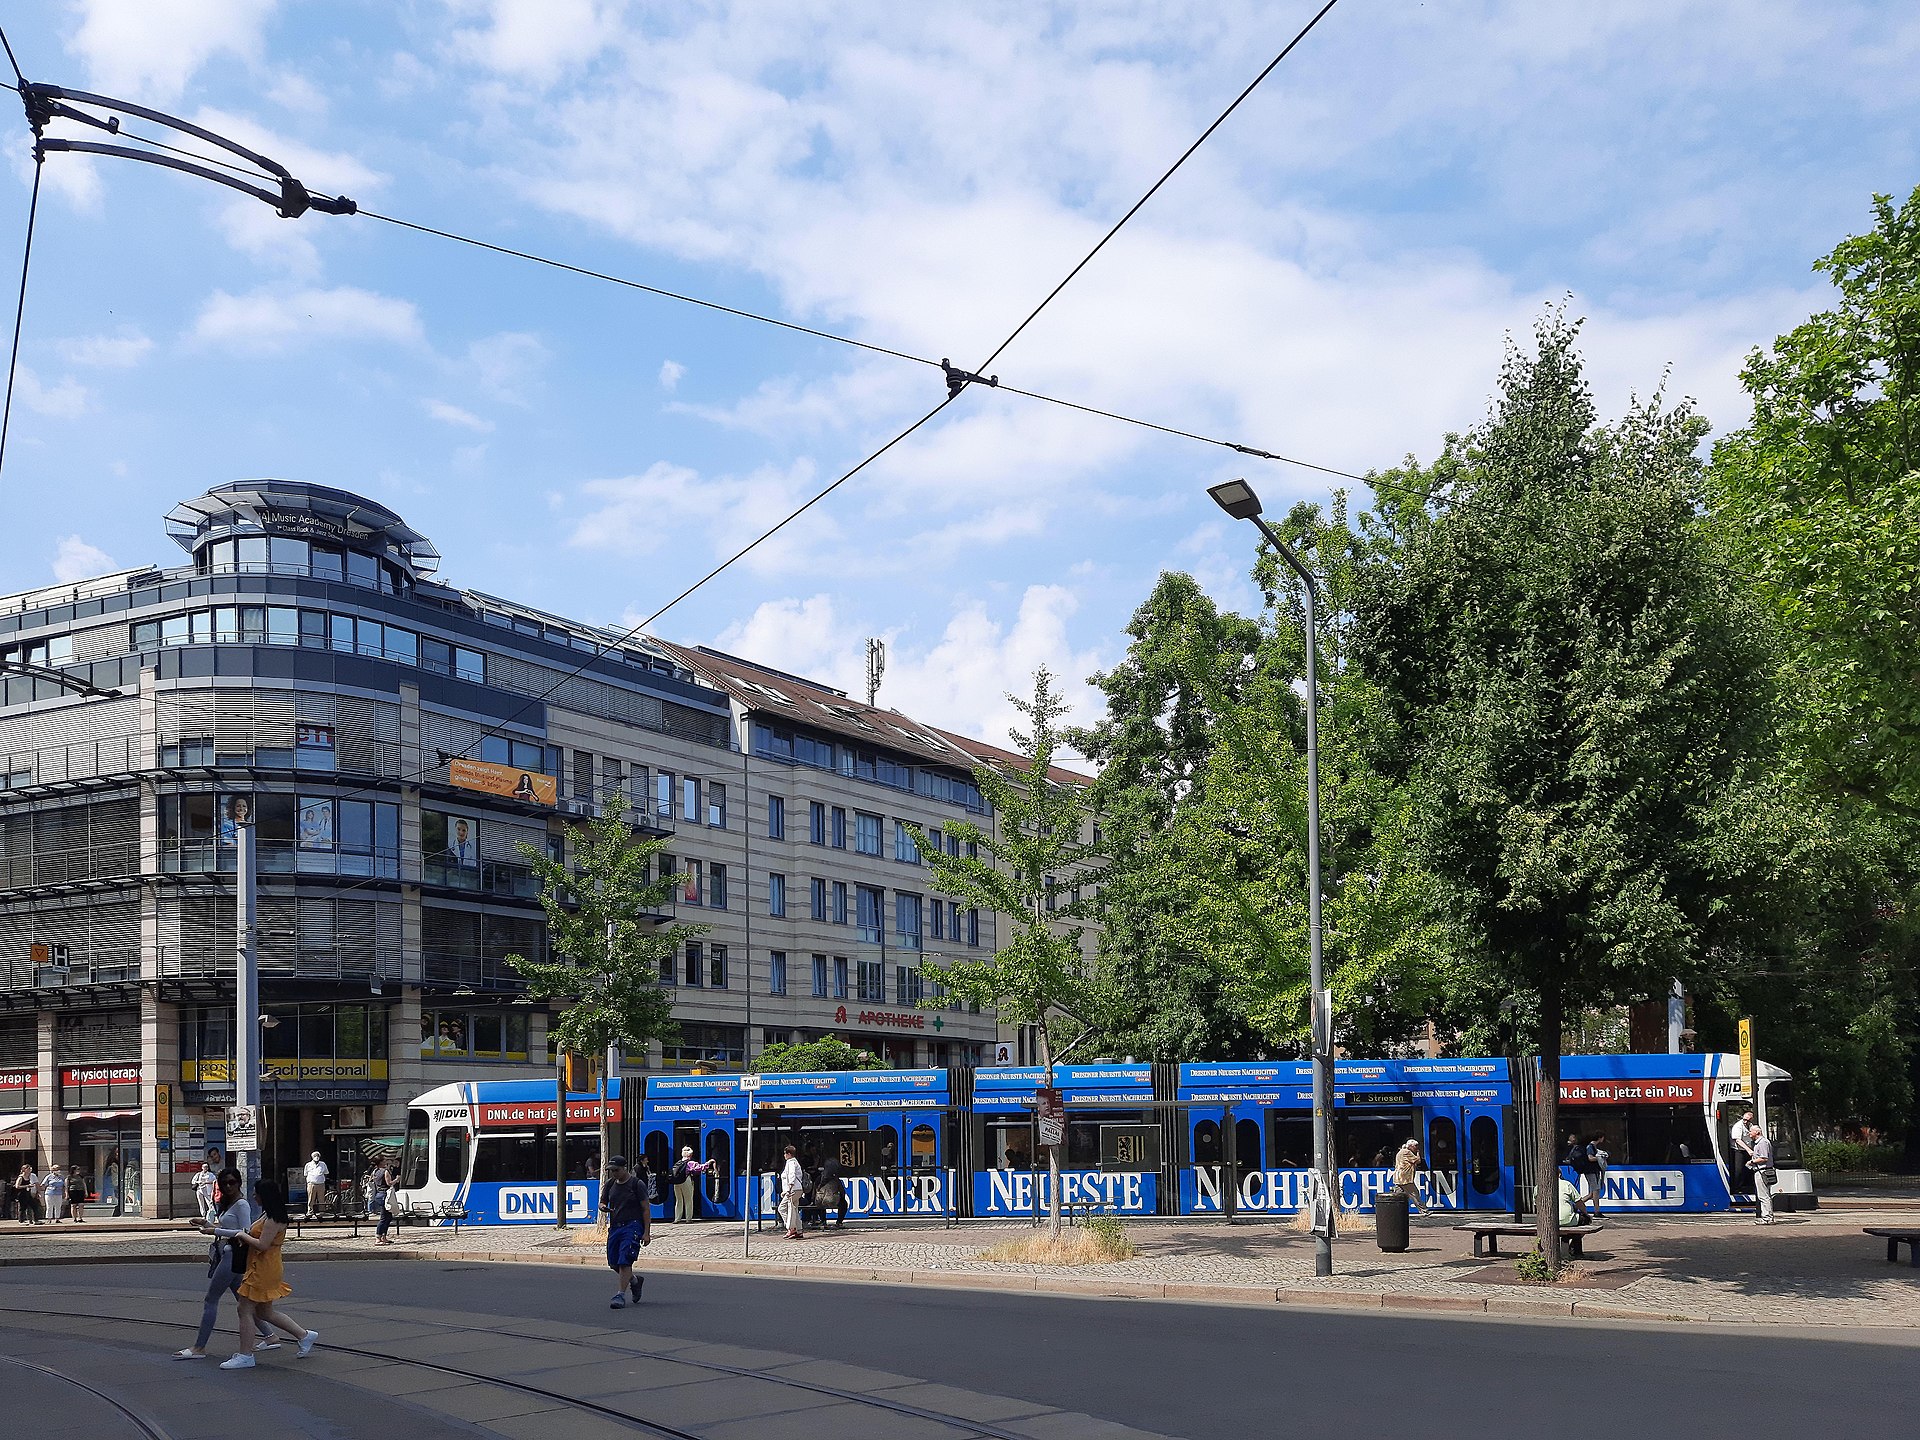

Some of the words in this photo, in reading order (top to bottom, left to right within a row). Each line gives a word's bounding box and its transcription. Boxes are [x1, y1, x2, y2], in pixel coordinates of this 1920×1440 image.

[272, 512, 297, 523] Music
[298, 514, 336, 532] Academy
[337, 525, 369, 540] Dresden
[858, 1010, 925, 1029] APOTHEKE
[264, 1063, 367, 1078] Fachpersonal
[744, 1079, 758, 1087] TAXI
[1352, 1094, 1361, 1102] 12
[1368, 1094, 1404, 1102] Striesen
[1559, 1086, 1587, 1098] N.de
[1590, 1086, 1611, 1098] hat
[1613, 1086, 1642, 1101] jetzt
[1645, 1086, 1664, 1097] ein
[1668, 1085, 1693, 1097] Plus
[445, 1109, 468, 1118] DVB
[487, 1108, 524, 1120] DNN.de
[527, 1108, 545, 1119] hat
[546, 1107, 571, 1121] jet
[573, 1106, 590, 1118] ein
[594, 1106, 615, 1117] Ps
[1193, 1165, 1459, 1210] NCHRCHEN
